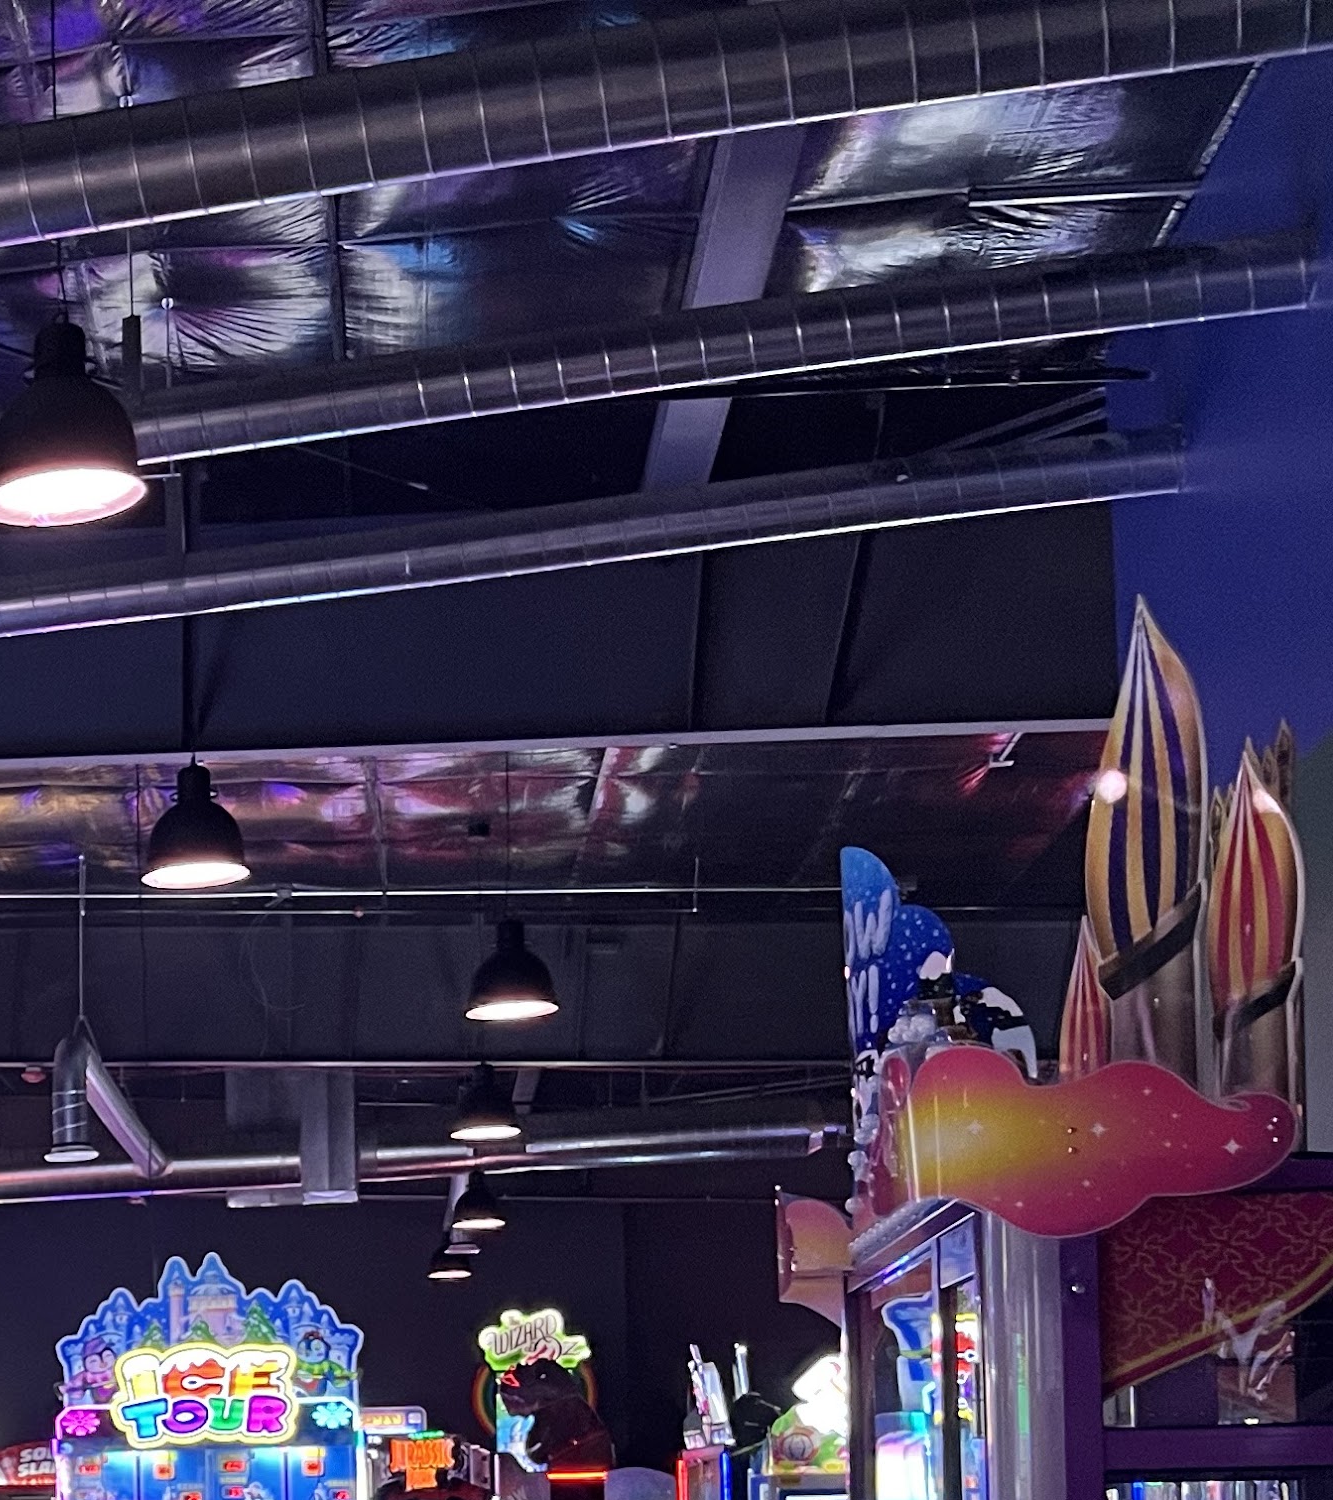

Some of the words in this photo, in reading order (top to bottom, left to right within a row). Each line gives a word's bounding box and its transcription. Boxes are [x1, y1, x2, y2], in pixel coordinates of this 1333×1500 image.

[486, 1314, 558, 1356] WIZARD
[123, 1348, 291, 1400] ICE
[122, 1395, 288, 1439] TOUR
[363, 1414, 403, 1425] -MAN
